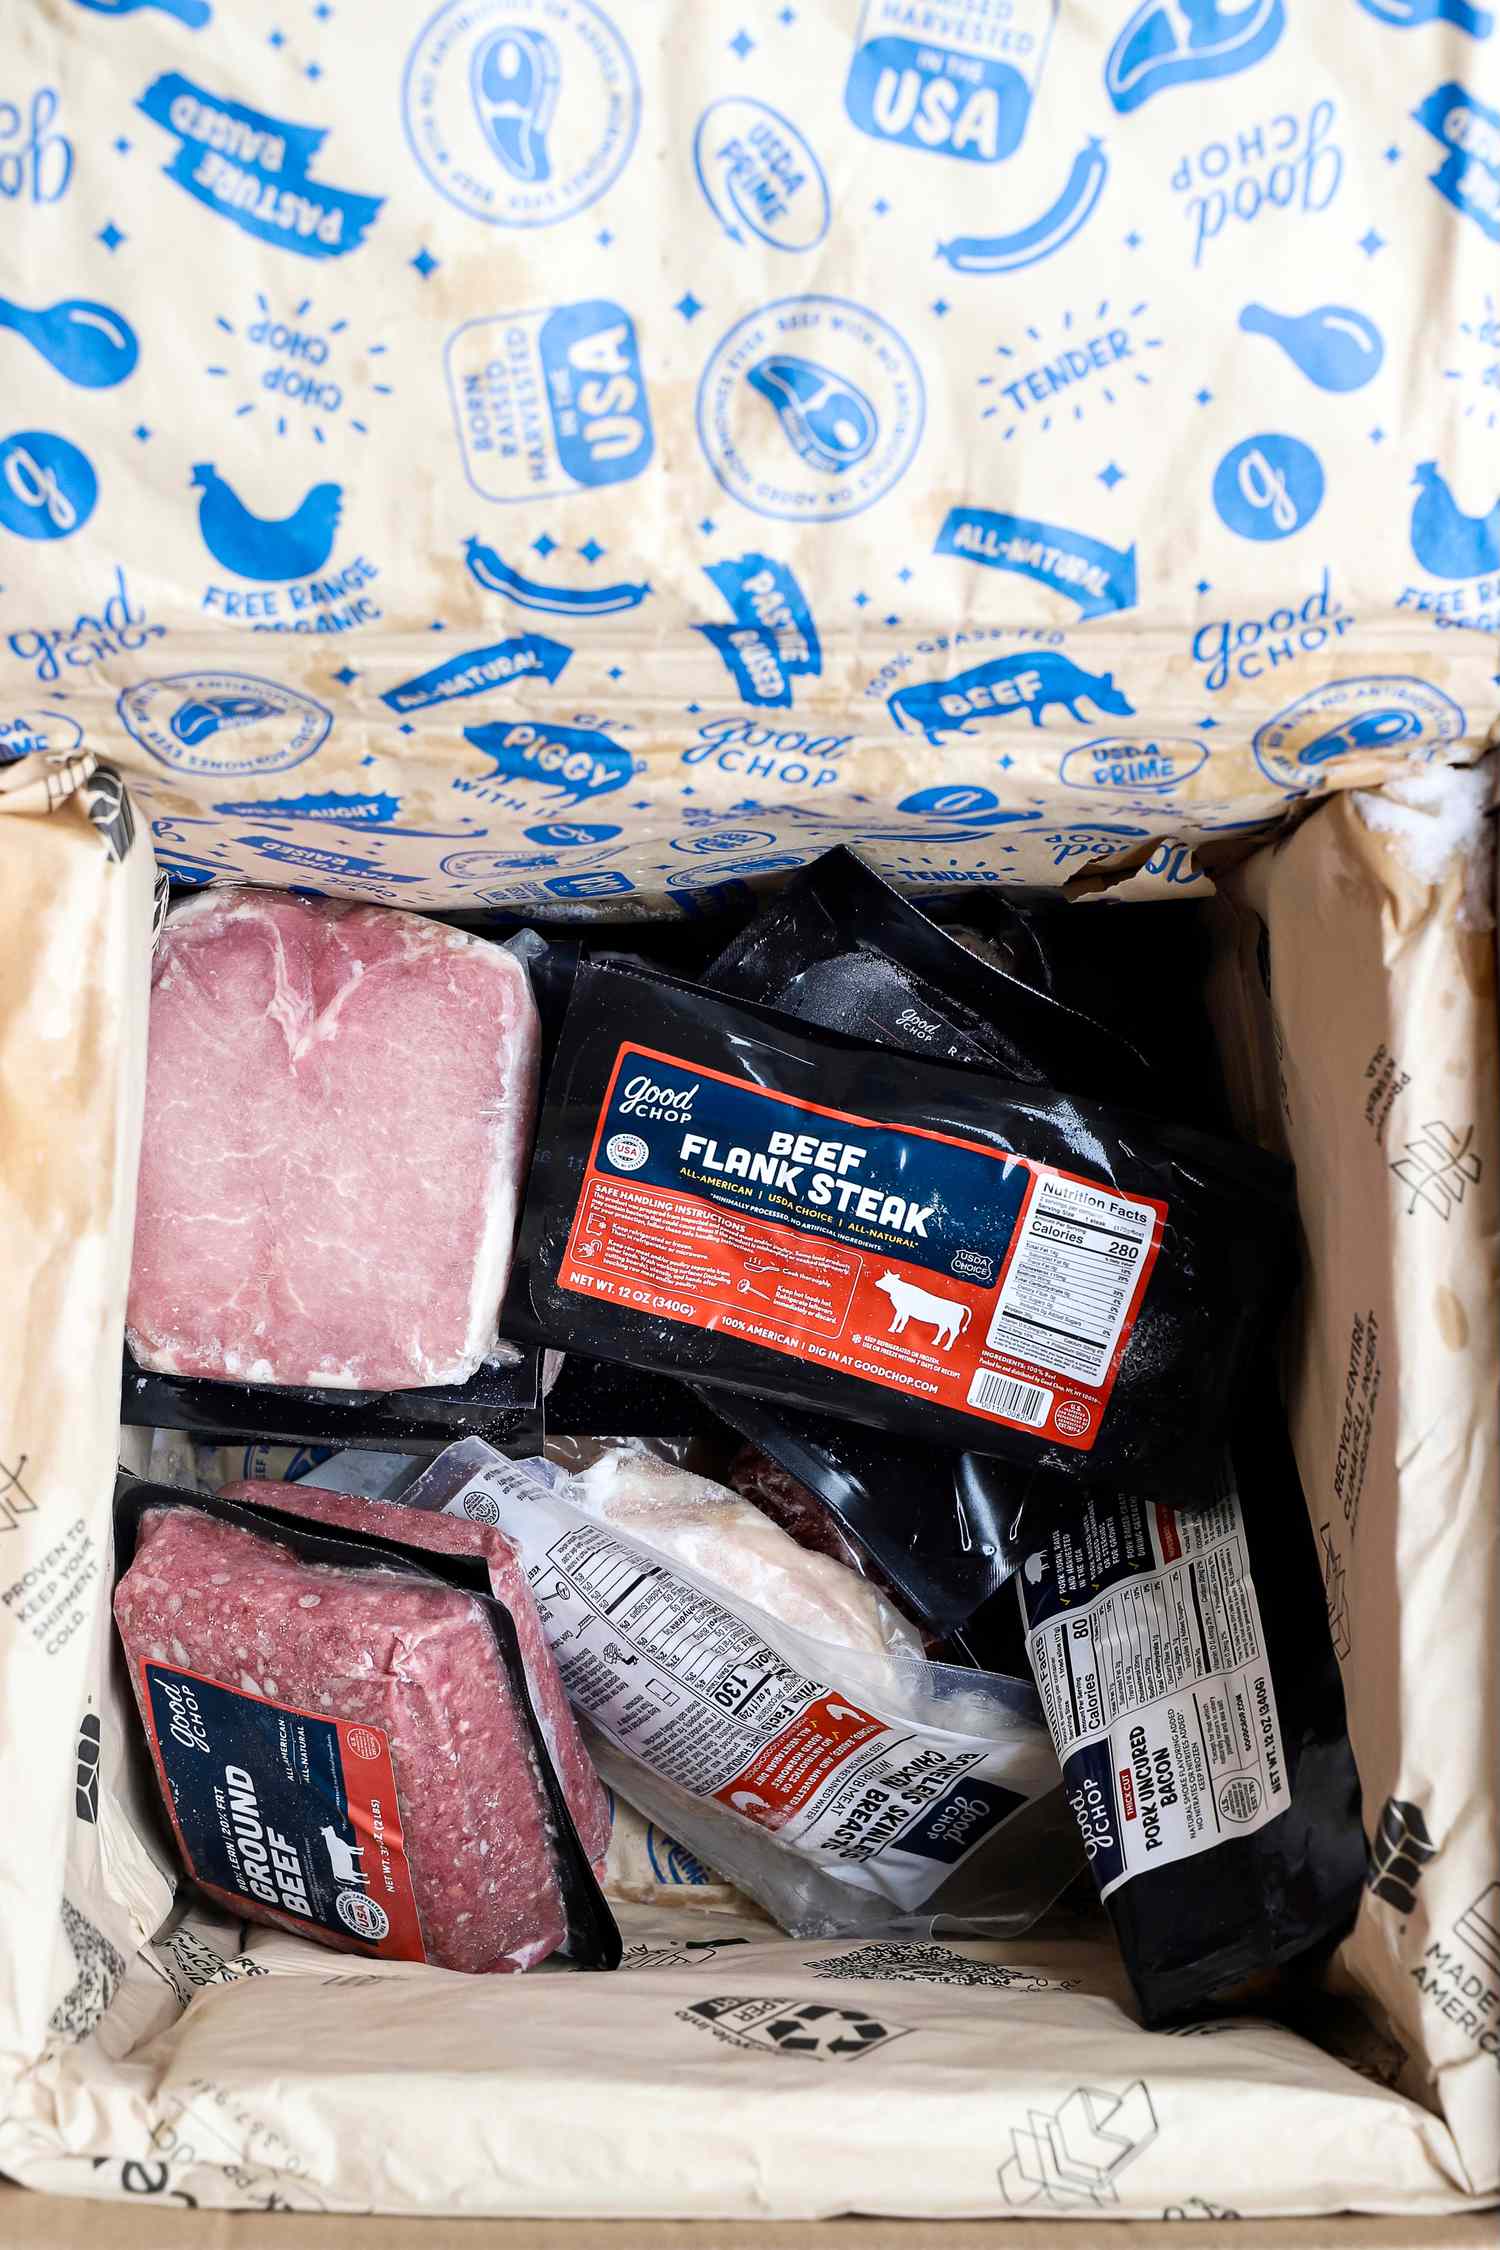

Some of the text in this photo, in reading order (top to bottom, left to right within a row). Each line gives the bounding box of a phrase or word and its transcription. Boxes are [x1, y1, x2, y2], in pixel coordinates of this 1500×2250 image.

[881, 3, 1034, 56] HARVESTED
[872, 66, 1001, 162] USA
[748, 122, 806, 198] USDA
[1171, 114, 1299, 191] CHOP
[1185, 100, 1344, 268] good
[248, 319, 330, 366] CHOP
[261, 366, 344, 413] CHOP
[566, 325, 644, 461] USA
[1001, 327, 1135, 415] TENDER
[462, 373, 494, 454] BORN
[203, 556, 384, 617] FREE RANGE
[953, 525, 1111, 600] ALL-NATURAL
[1192, 564, 1341, 691] good
[1237, 614, 1356, 679] CHOP
[938, 670, 1043, 717] BEEF
[503, 726, 622, 790] PIGGY
[682, 716, 856, 766] good
[1091, 743, 1160, 762] USDA
[717, 750, 839, 788] CHOP
[1092, 757, 1176, 787] PRIME
[450, 776, 530, 813] WITH
[896, 869, 1002, 881] TENDER
[895, 1007, 941, 1037] good
[902, 1022, 935, 1043] CHOP
[618, 1075, 701, 1114] good
[635, 1104, 693, 1125] CHOP
[616, 1142, 638, 1159] USA
[766, 1130, 868, 1177] BEEF
[594, 1184, 747, 1234] SAFE HANDLING INSTRUCTIONS
[679, 1131, 807, 1197] FLANK
[806, 1171, 936, 1239] STEAK
[679, 1166, 754, 1198] ALL-AMERICAN
[767, 1193, 795, 1211] USDA
[794, 1202, 834, 1223] CHOICE
[1043, 1181, 1106, 1211] Nutrition
[1108, 1200, 1149, 1225] Facts
[960, 1250, 988, 1267] USDA
[1031, 1220, 1084, 1245] Calories
[1107, 1240, 1139, 1260] 280
[953, 1259, 989, 1278] CHOICE
[569, 1271, 697, 1318] NET WT. 12 OZ (340G)
[721, 1315, 939, 1396] 100% AMERICAN DIG IN AT GOODCHOP.COM
[1346, 1311, 1360, 1397] ENTIRE
[1, 1518, 87, 1606] PROVEN TO
[60, 1535, 95, 1581] YOUR
[1060, 1533, 1077, 1589] AND HARVESTED
[1105, 1516, 1120, 1563] FOR GROWTH
[1056, 1574, 1067, 1593] PORK
[1074, 1547, 1087, 1587] IN THE USA
[32, 1559, 99, 1641] SHIPMENT
[664, 1653, 681, 1670] 27%
[1033, 1636, 1049, 1679] Facts
[1070, 1617, 1102, 1729] Calories 80
[713, 1673, 750, 1707] 130
[736, 1691, 766, 1721] oz (112g)
[1074, 1676, 1088, 1733] Amount Serving
[1136, 1669, 1145, 1703] Cholesterol
[153, 1677, 211, 1753] good
[184, 1685, 208, 1741] CHOP
[759, 1704, 793, 1733] Facts
[1252, 1676, 1283, 1793] NET WT. 12 OZ (340G)
[296, 1725, 311, 1782] ALL-NATURAL
[752, 1726, 810, 1785] ALL VEGETARIAN DIET
[779, 1737, 833, 1794] NO ANTIBIOTICS OR
[799, 1732, 822, 1753] ADDED
[1190, 1741, 1205, 1791] KEEP FROZEN
[213, 1786, 226, 1809] FAT
[789, 1766, 823, 1806] HARVESTED
[805, 1765, 851, 1820] RETAINED WATER
[829, 1760, 893, 1816] WITH RIB MEAT
[1121, 1773, 1134, 1815] THICK CUT
[1127, 1724, 1163, 1851] PORK UNCURED
[1151, 1746, 1178, 1808] BACON
[1167, 1707, 1197, 1839] NATURAL SMOKE FLAVORING ADDED
[1180, 1739, 1205, 1830] NO NITRATES OR NITRITES
[218, 1811, 231, 1835] 20%
[819, 1749, 947, 1852] CHICKEN BREASTS
[927, 1806, 960, 1840] CHOP
[943, 1796, 990, 1845] good
[1082, 1776, 1111, 1833] CHOP
[224, 1843, 240, 1868] LEAN
[225, 1765, 279, 1902] GROUND
[370, 1799, 395, 1891] NET WT. (2 LBS)
[266, 1826, 312, 1916] BEEF
[352, 1903, 370, 1928] USA
[1425, 1941, 1496, 2016] MADE
